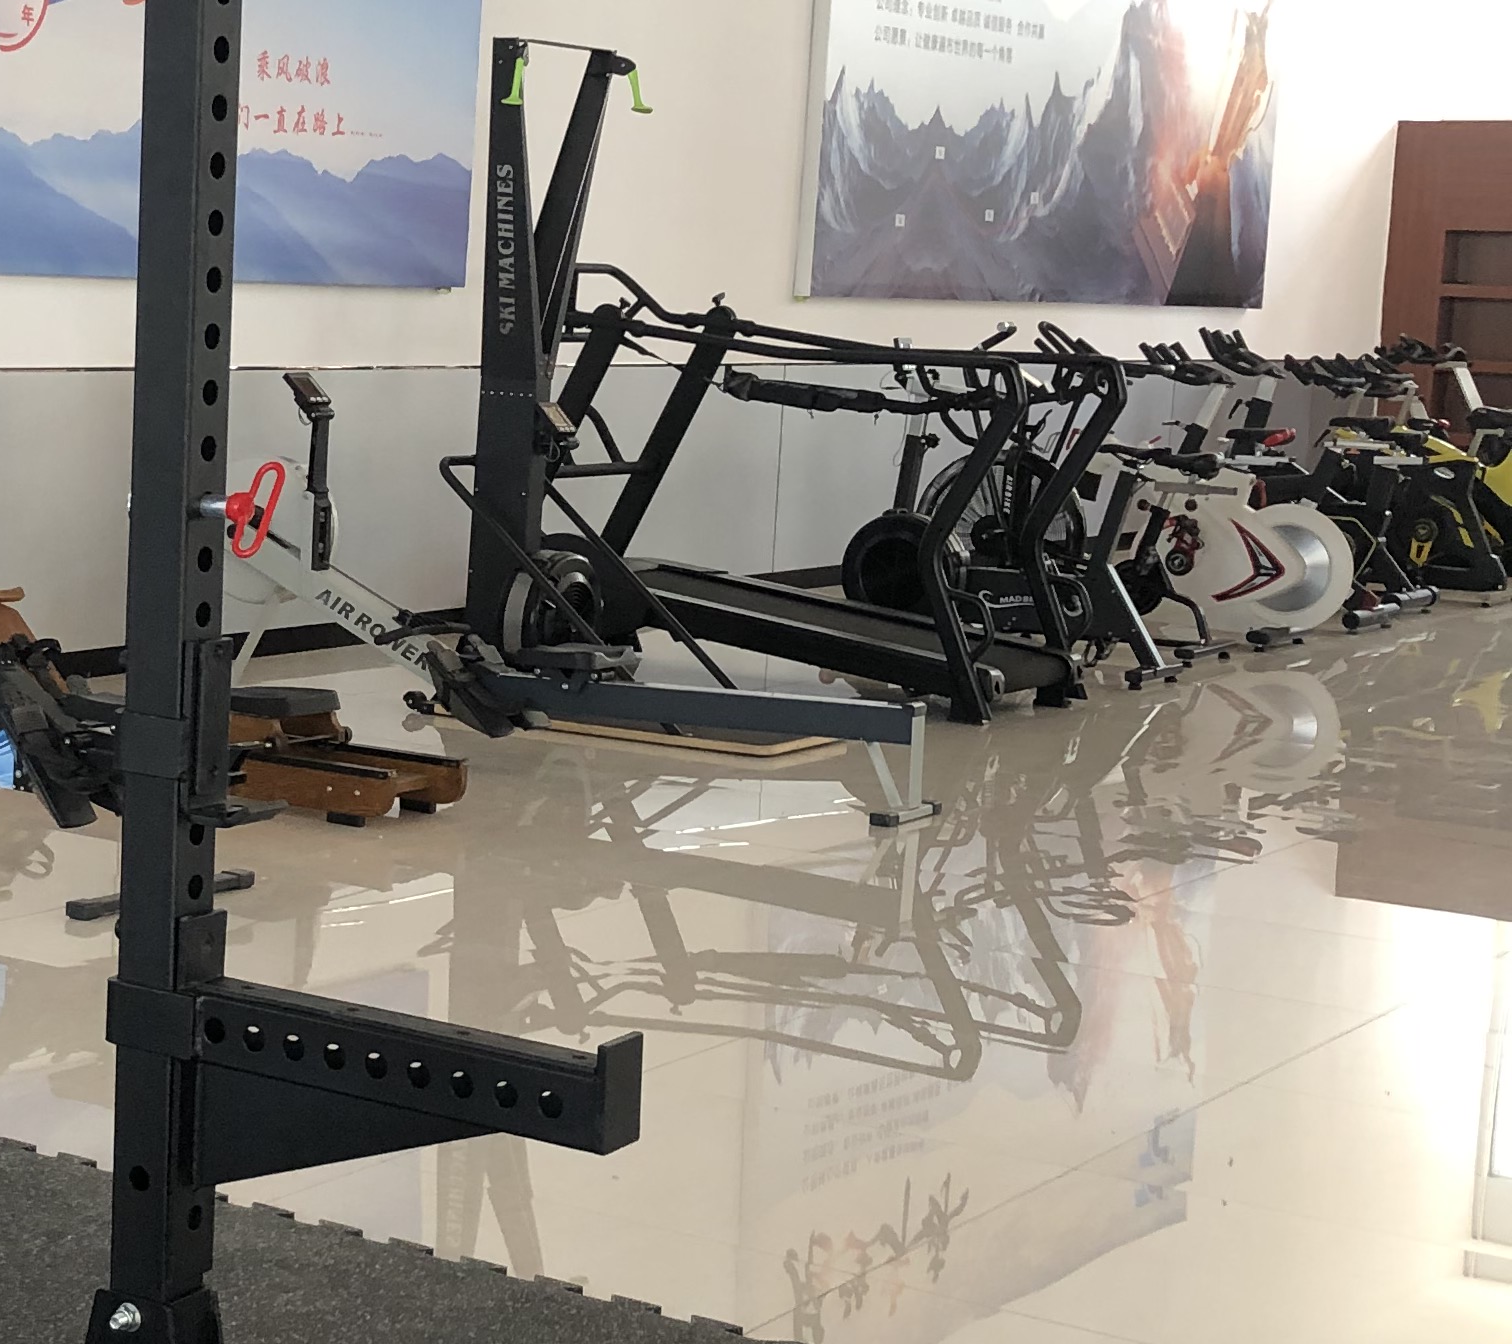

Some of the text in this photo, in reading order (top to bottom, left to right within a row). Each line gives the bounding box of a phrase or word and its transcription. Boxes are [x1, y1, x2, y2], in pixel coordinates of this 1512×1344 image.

[21, 4, 35, 26] 年
[257, 50, 330, 86] 乘风破浪
[496, 163, 517, 335] SKI MACHINES
[315, 589, 356, 620] AIR
